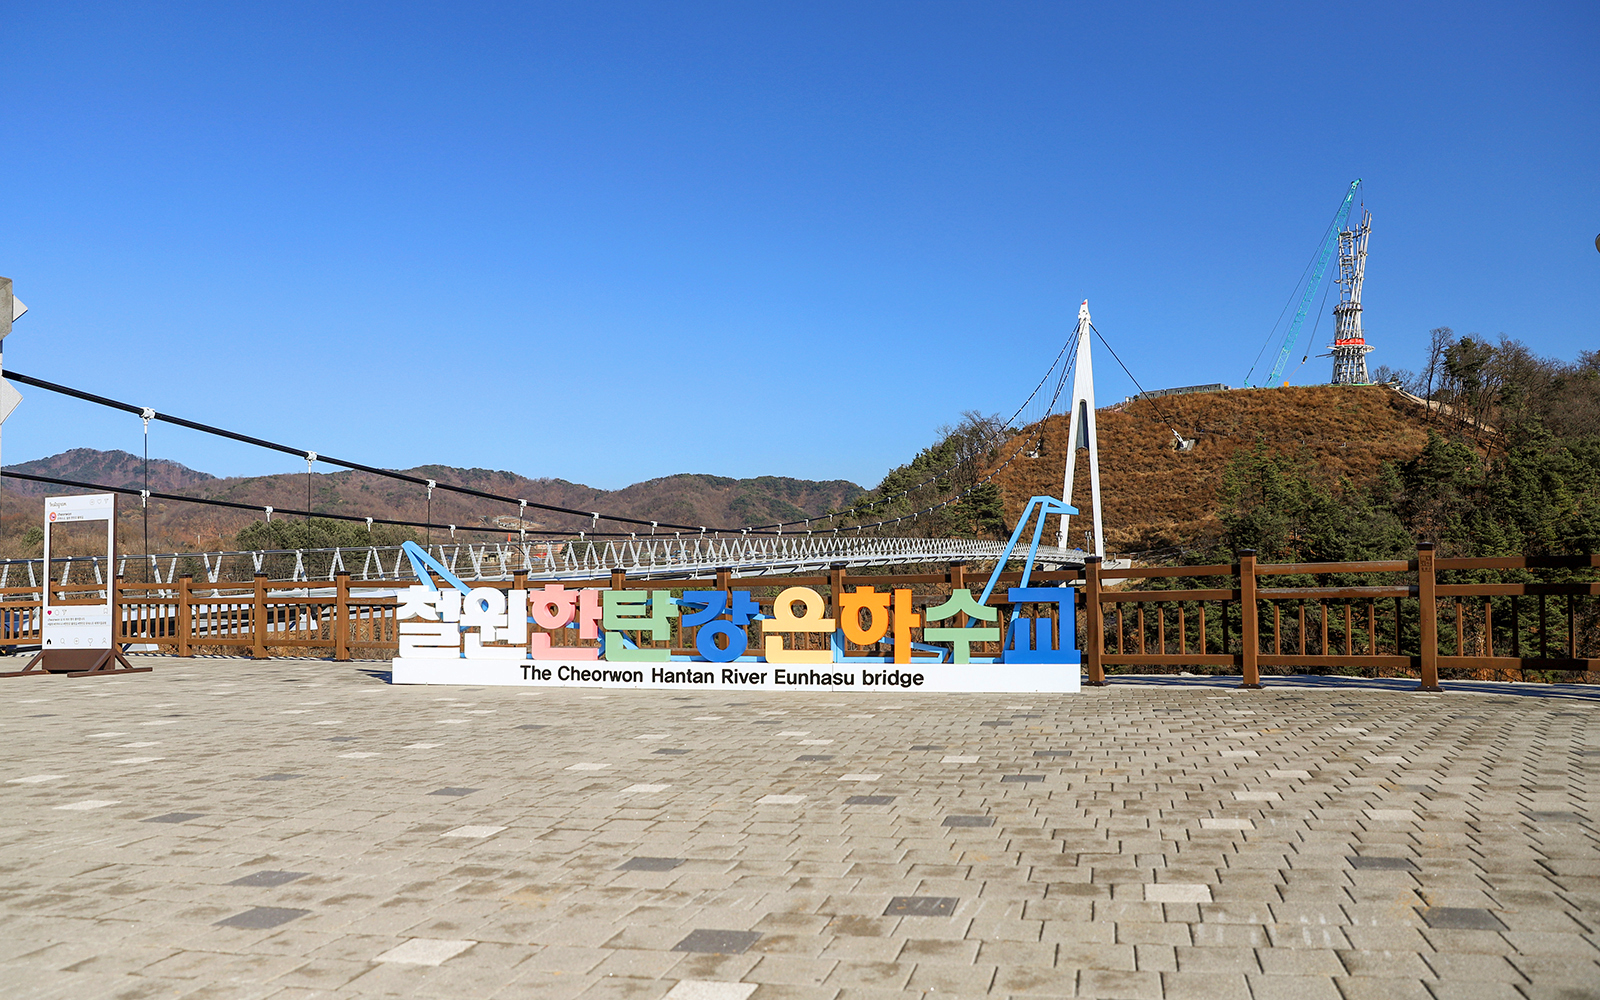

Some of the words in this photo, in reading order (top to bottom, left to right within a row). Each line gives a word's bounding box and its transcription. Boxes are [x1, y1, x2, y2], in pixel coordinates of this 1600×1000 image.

[520, 665, 551, 680] The
[558, 666, 643, 683] Cheorwon
[652, 668, 715, 684] Hantan
[722, 669, 767, 684] River
[775, 669, 854, 686] Eunhasu
[863, 670, 924, 688] bridge
